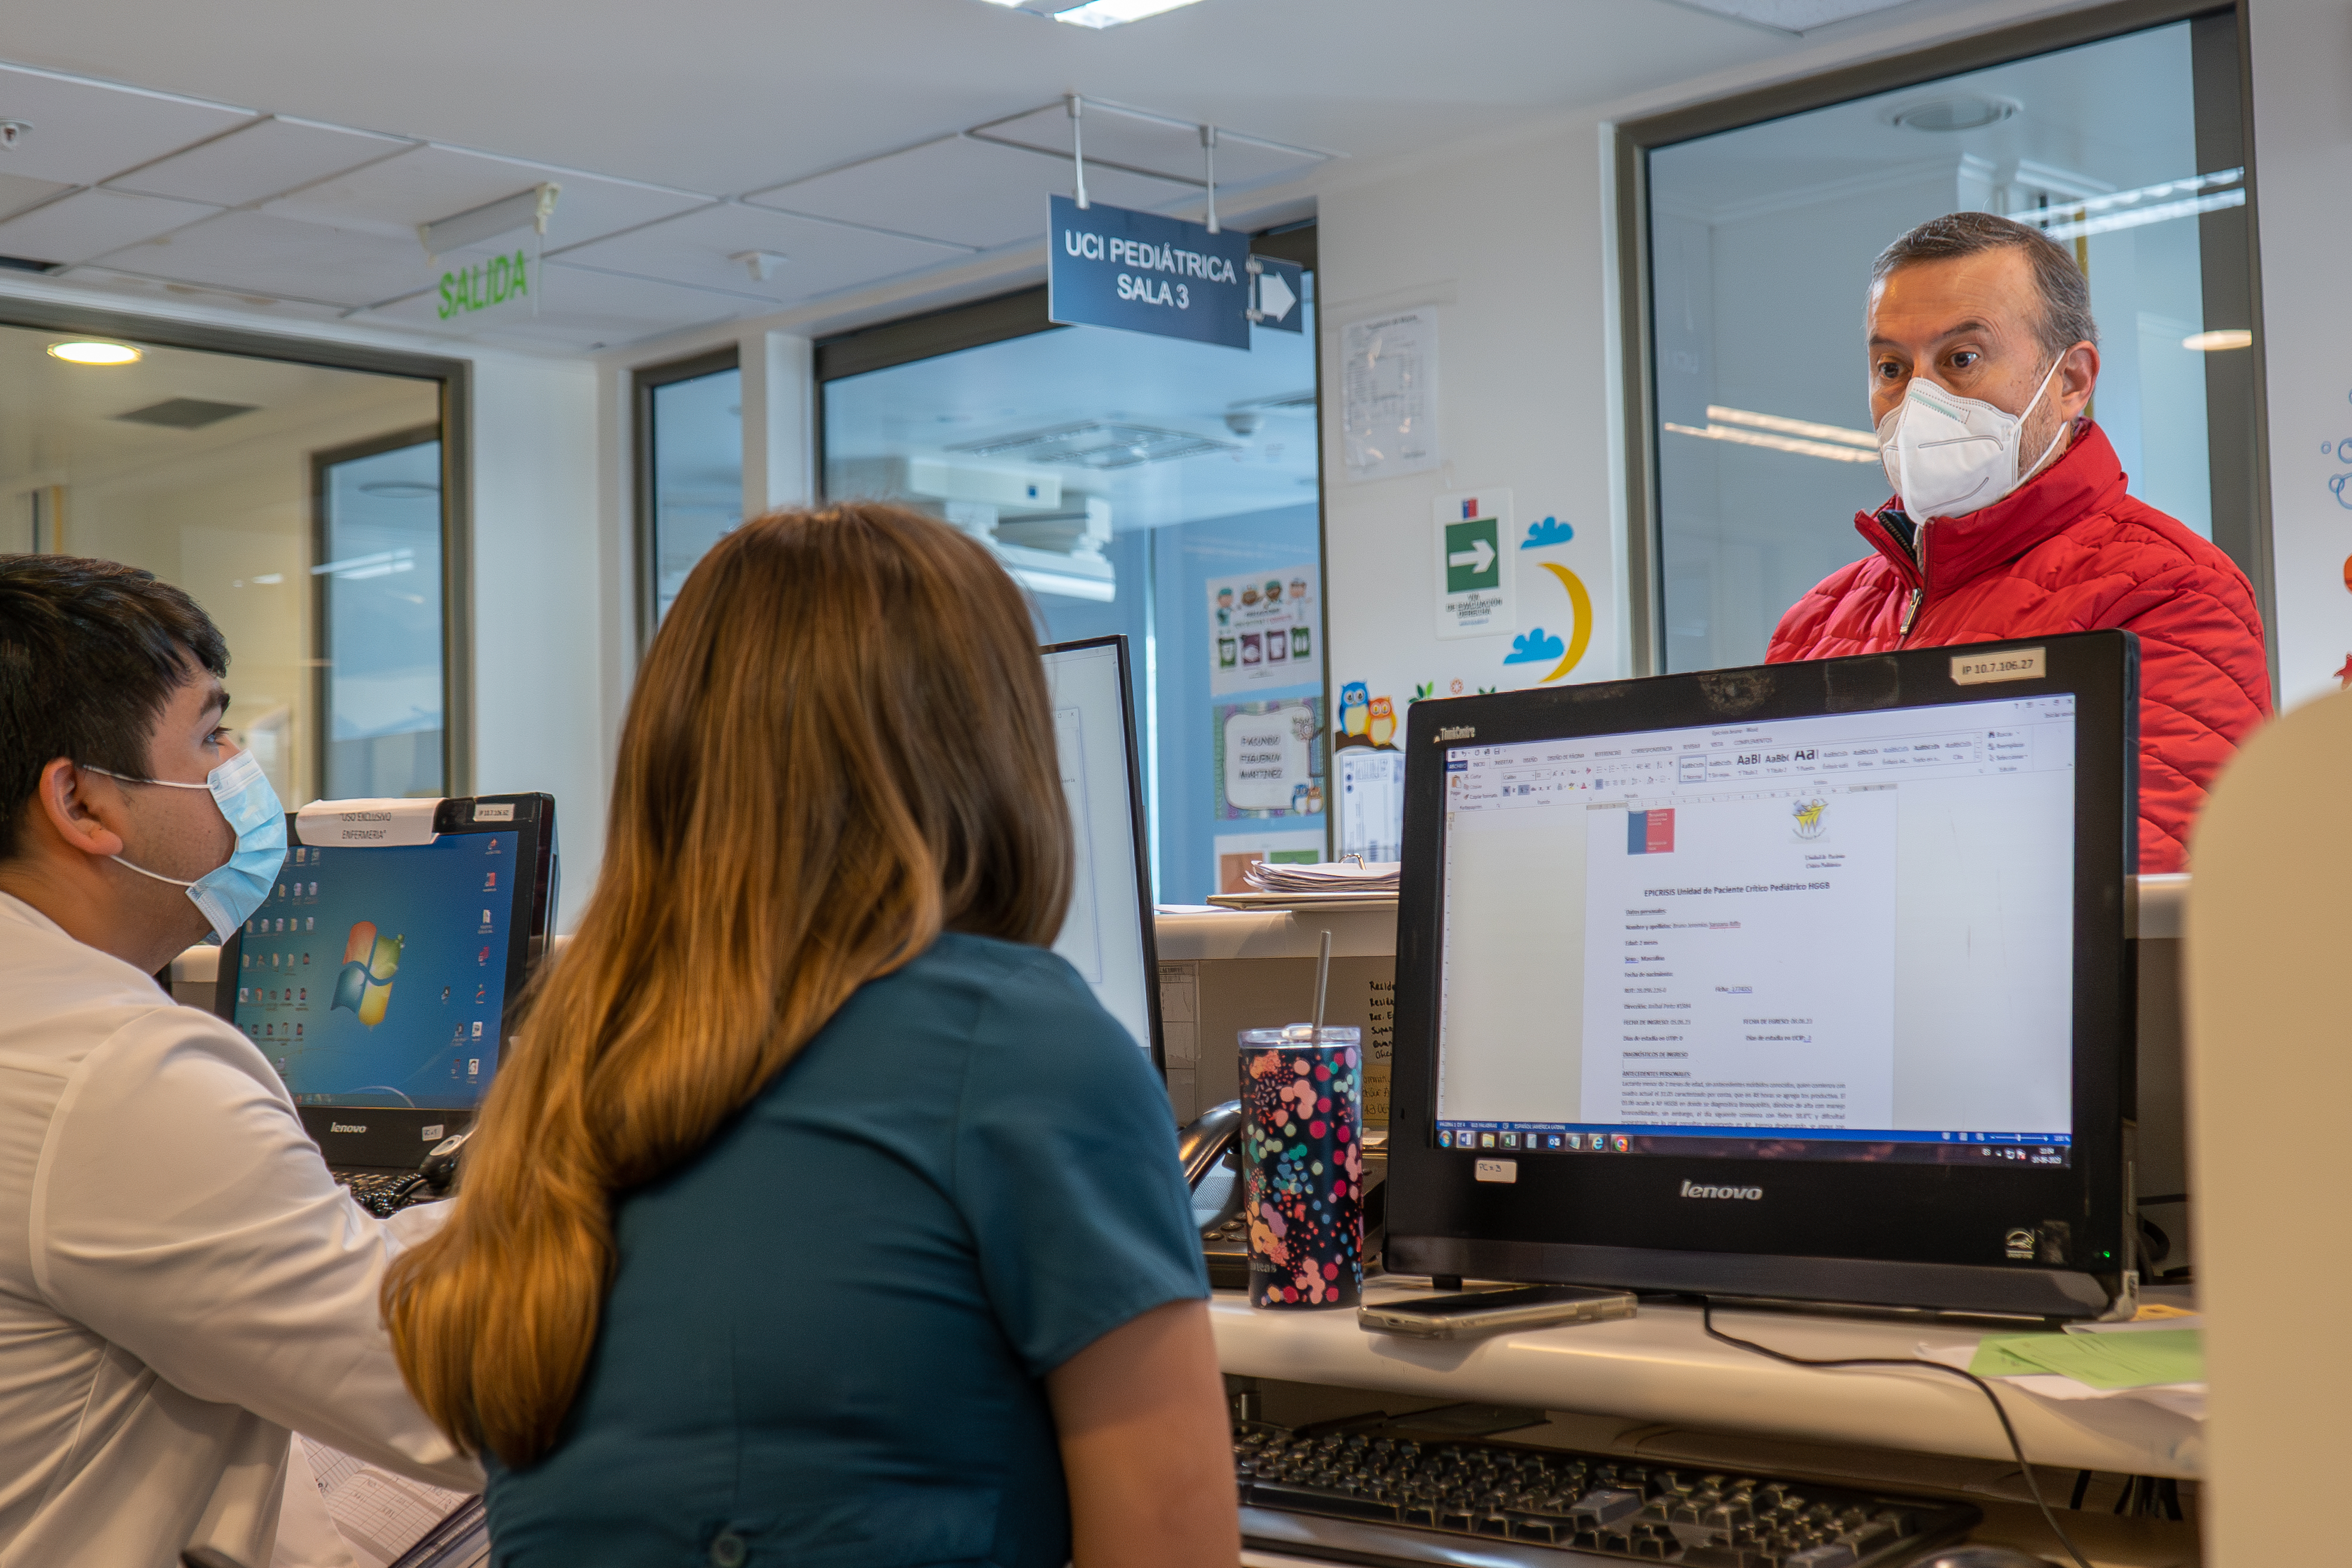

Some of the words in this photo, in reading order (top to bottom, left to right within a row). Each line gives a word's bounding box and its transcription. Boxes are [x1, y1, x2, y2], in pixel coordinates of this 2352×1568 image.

[1065, 229, 1104, 261] UCI
[1110, 237, 1238, 285] PEDIÁTRICA
[437, 247, 528, 320] SALIDA
[1117, 273, 1174, 307] SALA
[1177, 283, 1190, 309] 3
[1962, 665, 1972, 675] IP
[1644, 889, 1675, 897] EPICRISIS
[1677, 887, 1702, 895] Unidad
[1713, 886, 1744, 895] Paciente
[330, 1122, 367, 1133] lenovo
[1680, 1180, 1763, 1200] lenovo
